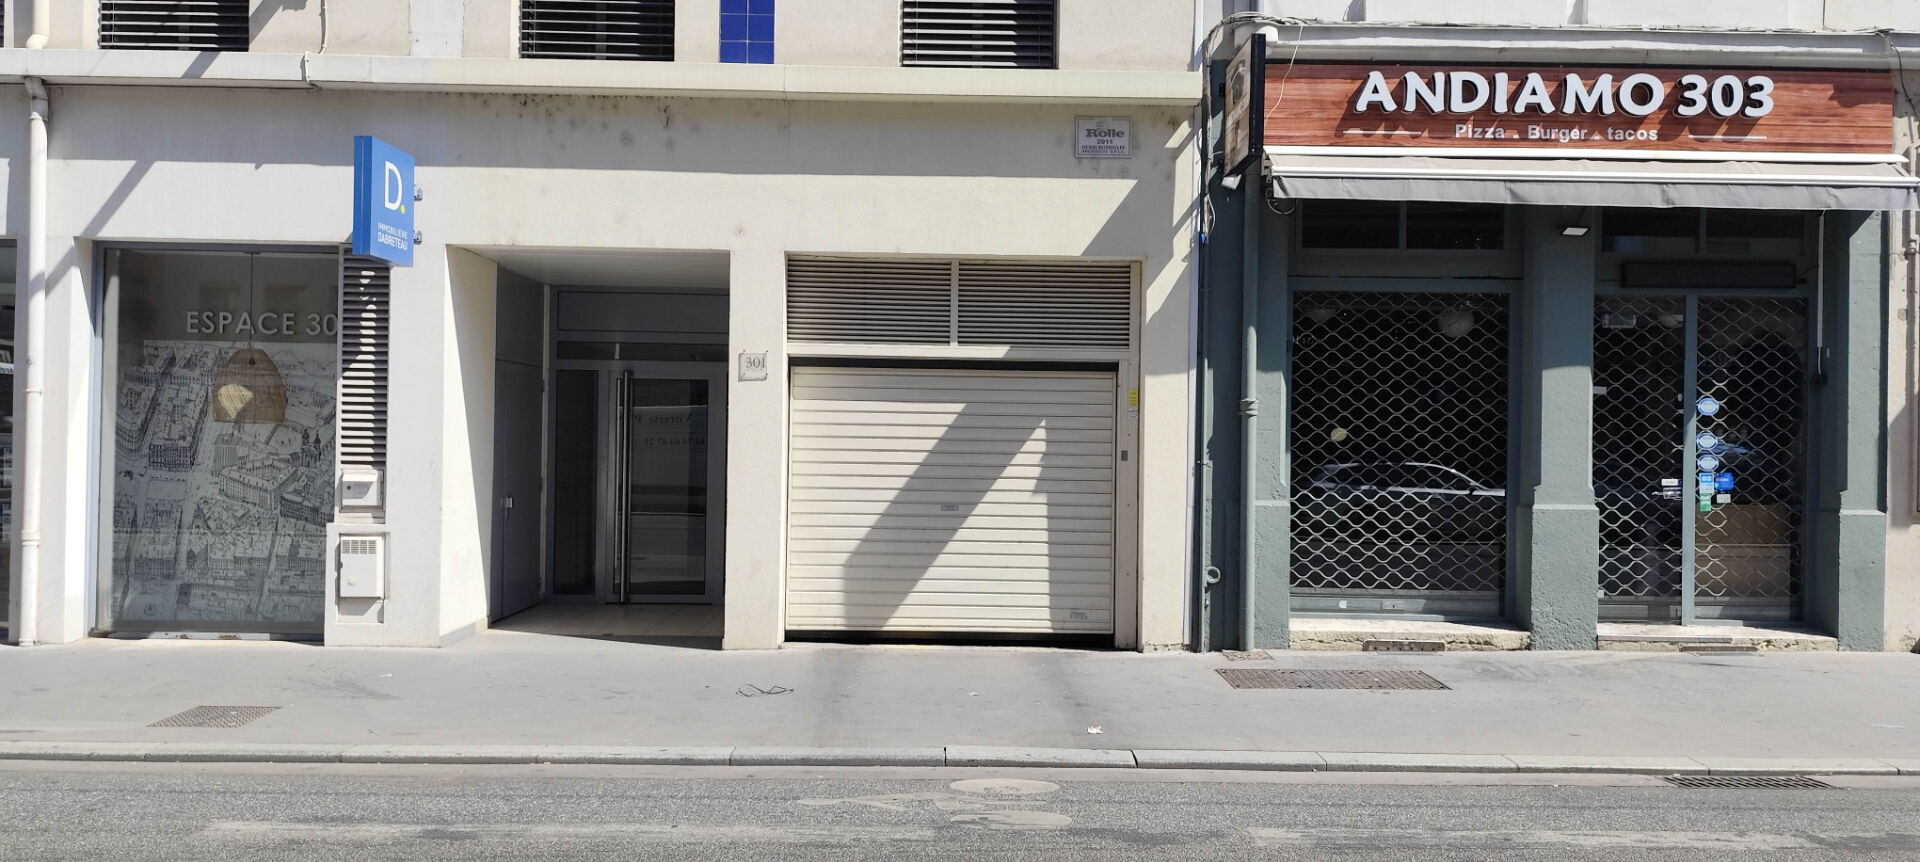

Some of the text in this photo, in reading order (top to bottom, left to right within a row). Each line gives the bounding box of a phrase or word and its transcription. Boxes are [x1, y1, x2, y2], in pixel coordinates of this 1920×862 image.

[1355, 70, 1774, 117] ANDIAMO 303
[1085, 128, 1125, 138] Rolle
[1455, 124, 1658, 143] Pizza Burger tacos
[186, 311, 296, 335] ESPACE
[745, 356, 766, 369] 301
